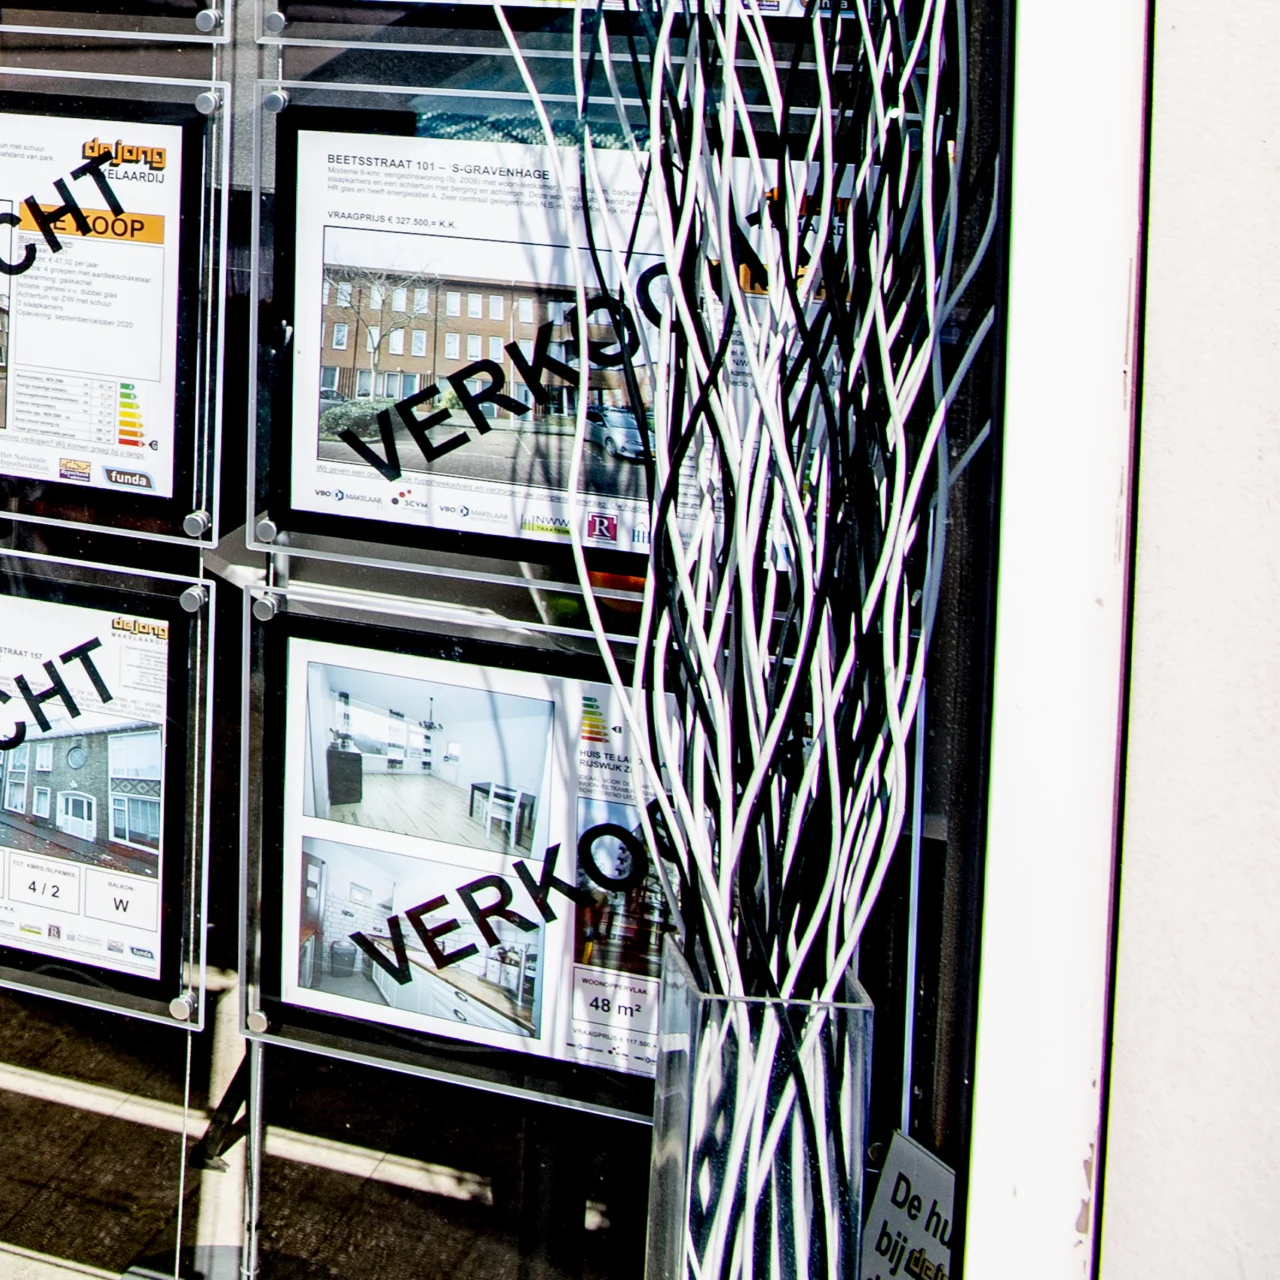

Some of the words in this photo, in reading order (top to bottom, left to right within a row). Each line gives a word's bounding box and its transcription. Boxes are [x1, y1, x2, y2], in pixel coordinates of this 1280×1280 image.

[327, 154, 412, 169] BEETSSTRAAT
[417, 161, 435, 171] 101
[450, 164, 550, 180] 'S-GRAVENHAGE
[327, 211, 385, 222] VRAAGPRIJS
[395, 216, 437, 227] 327.500,=
[117, 320, 133, 329] 2020
[111, 471, 147, 486] funda
[315, 489, 331, 497] VBO
[405, 499, 428, 509] SCYM
[31, 652, 42, 660] 157
[580, 750, 601, 759] HUIS
[580, 758, 622, 771] RIJSWIJK
[28, 880, 37, 893] 4
[51, 885, 60, 899] 2
[113, 897, 129, 912] W
[589, 997, 611, 1013] 48
[891, 1172, 922, 1221] De
[875, 1220, 909, 1276] bij
